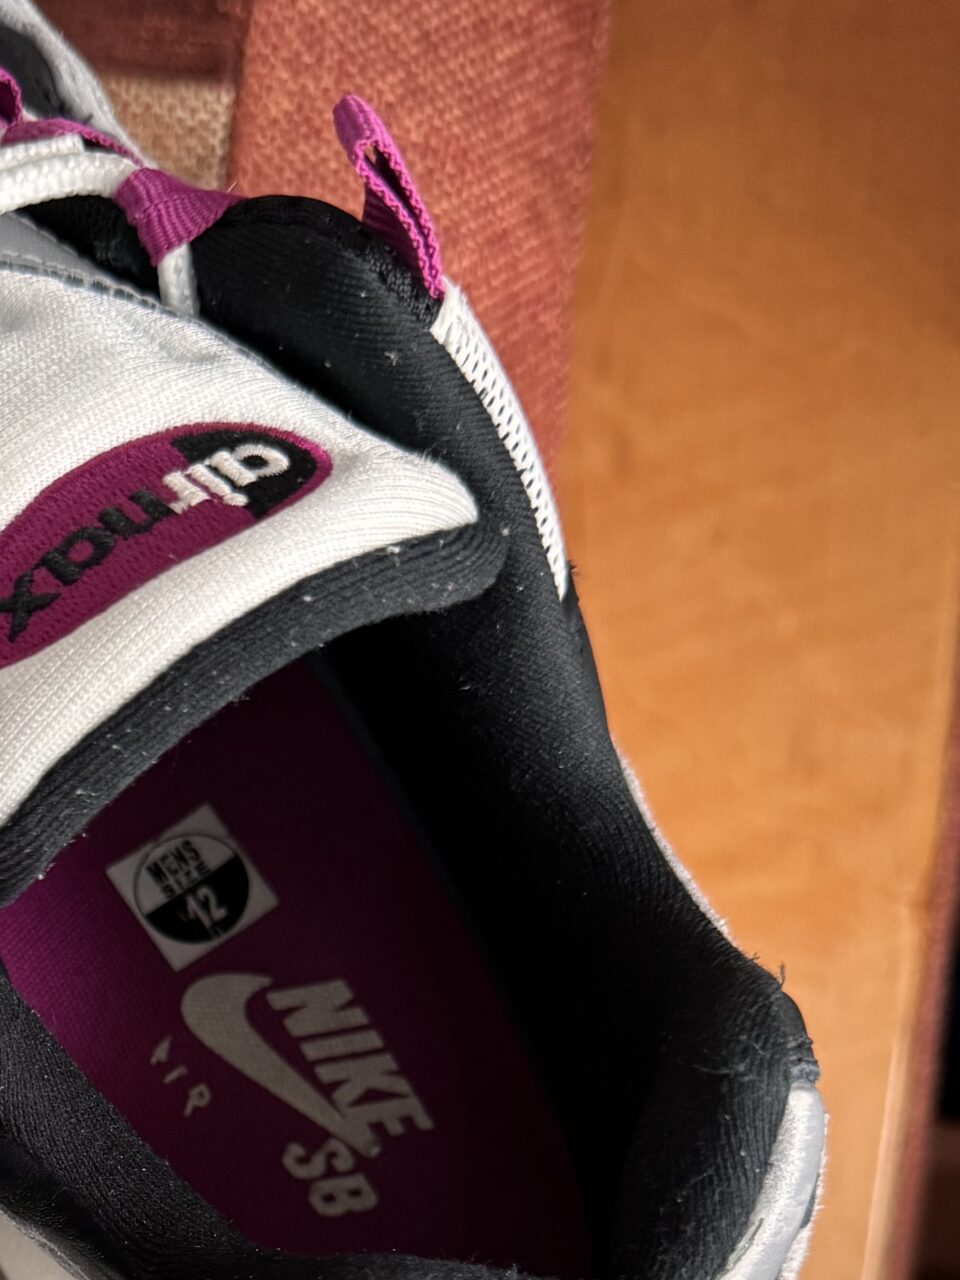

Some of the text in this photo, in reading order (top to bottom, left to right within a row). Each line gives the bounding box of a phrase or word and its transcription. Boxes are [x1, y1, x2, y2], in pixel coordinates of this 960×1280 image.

[146, 840, 200, 883] MENS
[162, 860, 211, 898] SIZE
[184, 883, 227, 928] 12
[266, 979, 434, 1136] NIKE
[281, 1138, 379, 1216] SB
